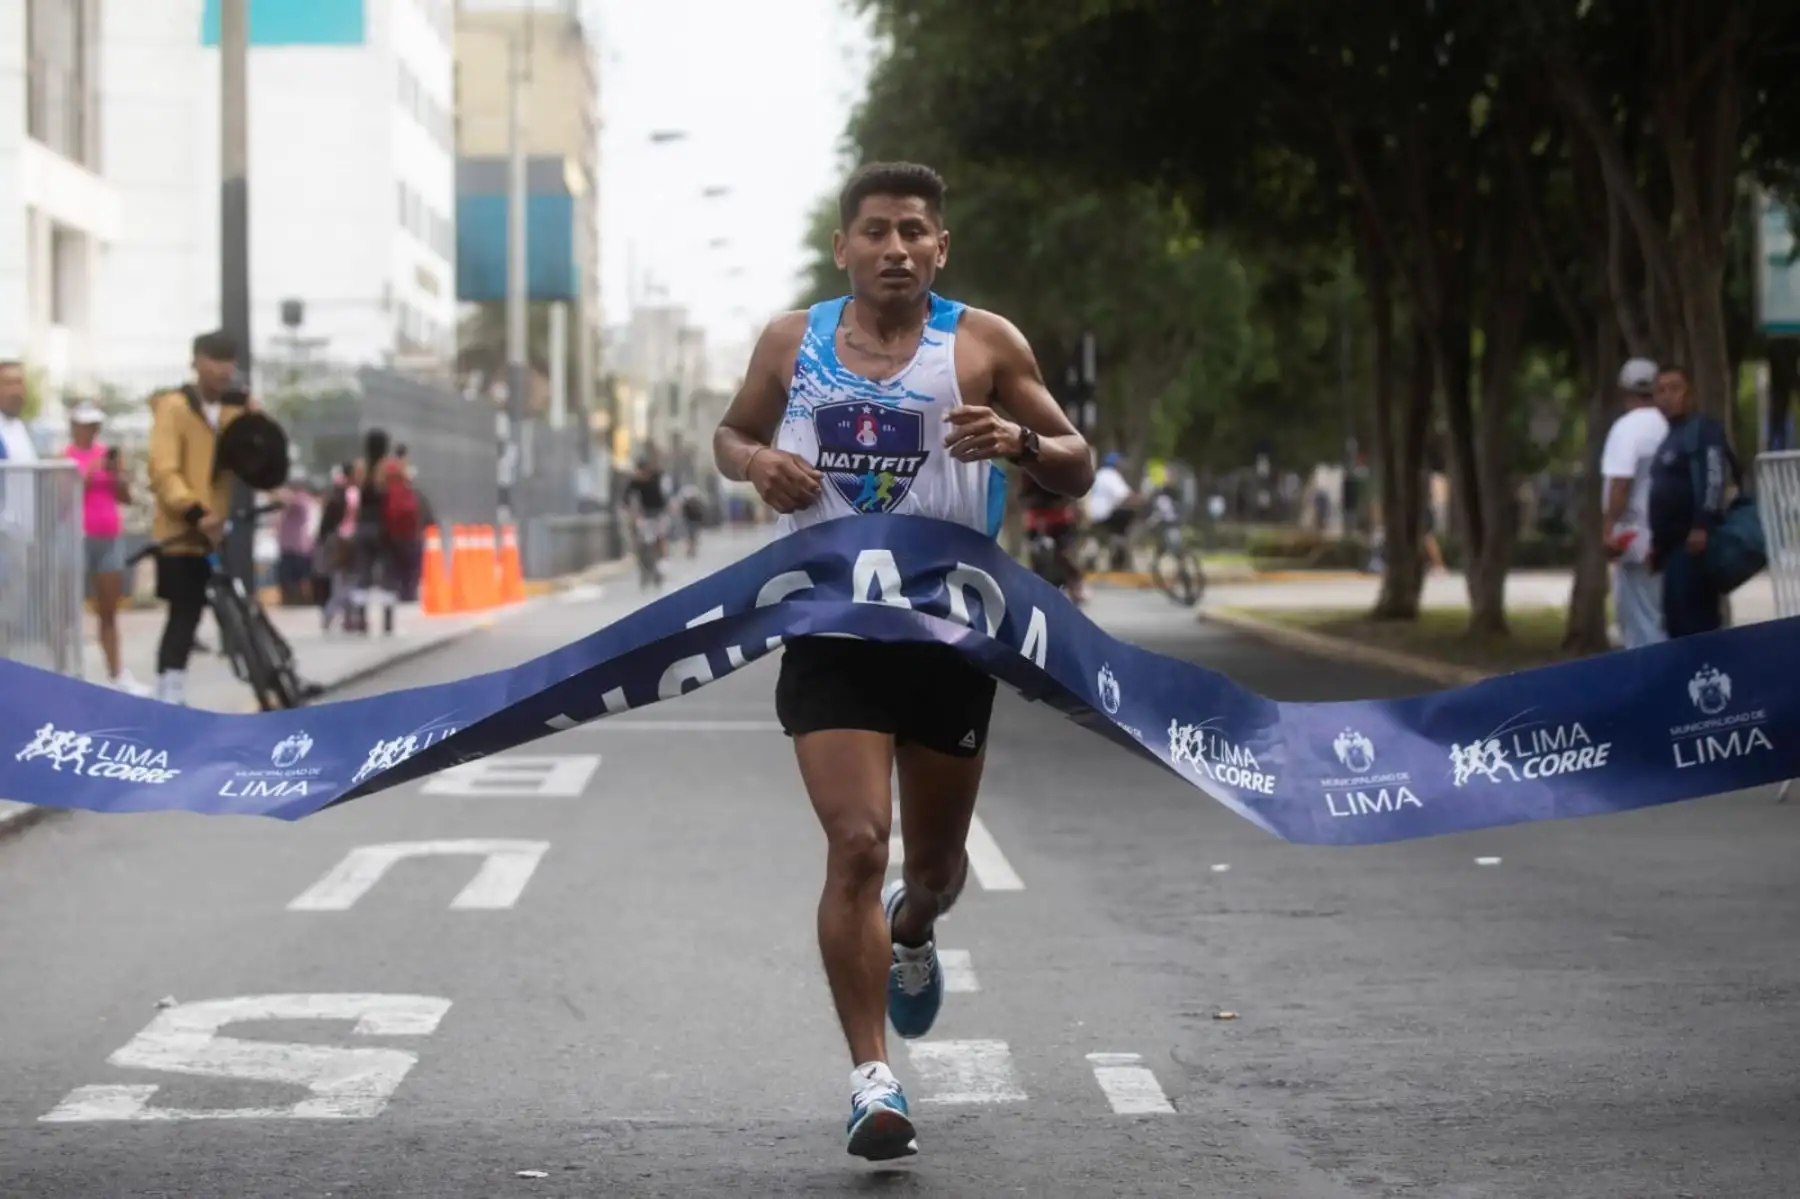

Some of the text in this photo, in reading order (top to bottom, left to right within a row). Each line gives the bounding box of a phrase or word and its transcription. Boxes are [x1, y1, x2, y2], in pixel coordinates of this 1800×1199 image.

[820, 451, 923, 473] NATYFIT
[97, 740, 169, 768] LIMA
[1210, 734, 1260, 771] LIMA
[1512, 721, 1591, 758] LIMA
[1672, 726, 1774, 768] LIMA
[87, 761, 182, 784] CORRE
[1522, 741, 1612, 779] CORRE
[219, 780, 308, 797] LIMA
[1215, 763, 1276, 795] CORRE
[1325, 786, 1423, 816] LIMA
